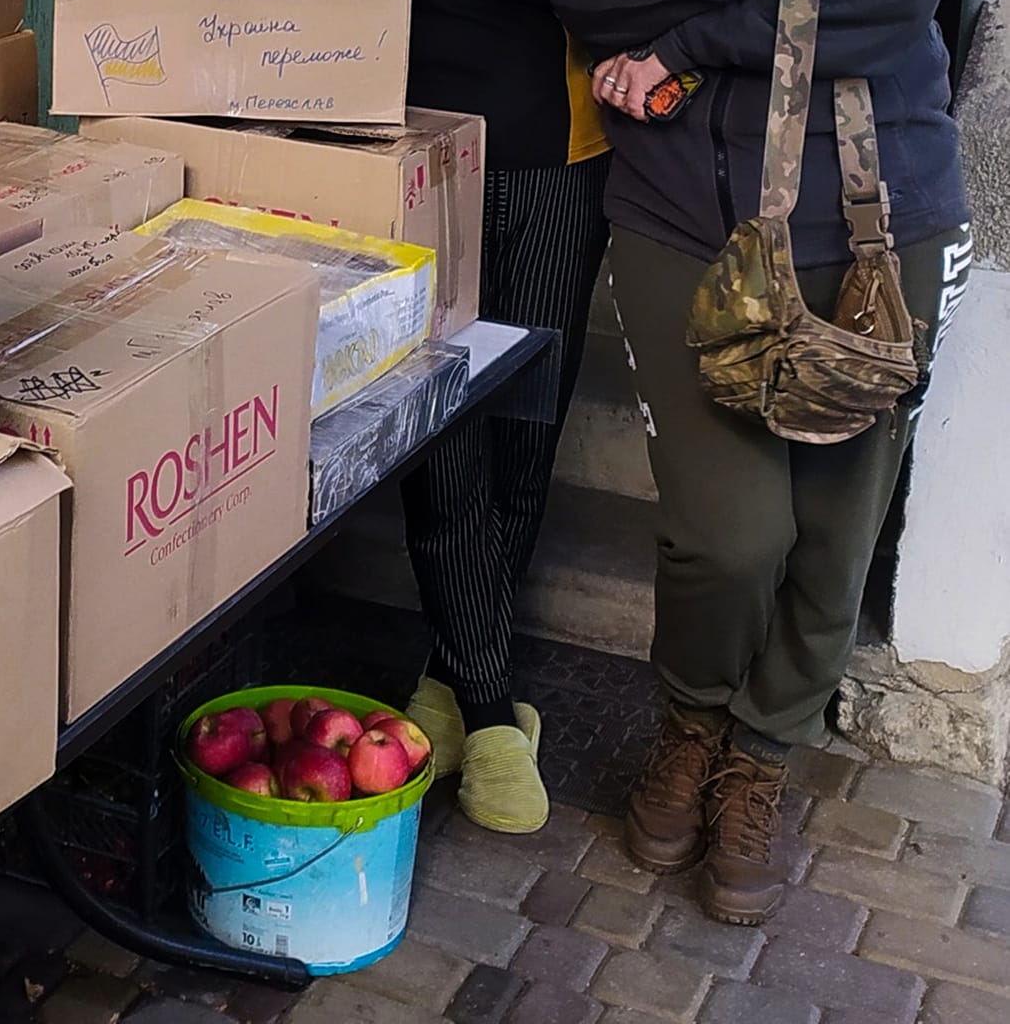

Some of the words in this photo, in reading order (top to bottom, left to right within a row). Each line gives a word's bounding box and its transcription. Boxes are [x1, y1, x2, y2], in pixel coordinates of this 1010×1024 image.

[198, 13, 301, 47] Україна
[124, 384, 280, 544] ROSHEN
[226, 484, 253, 514] Corp.
